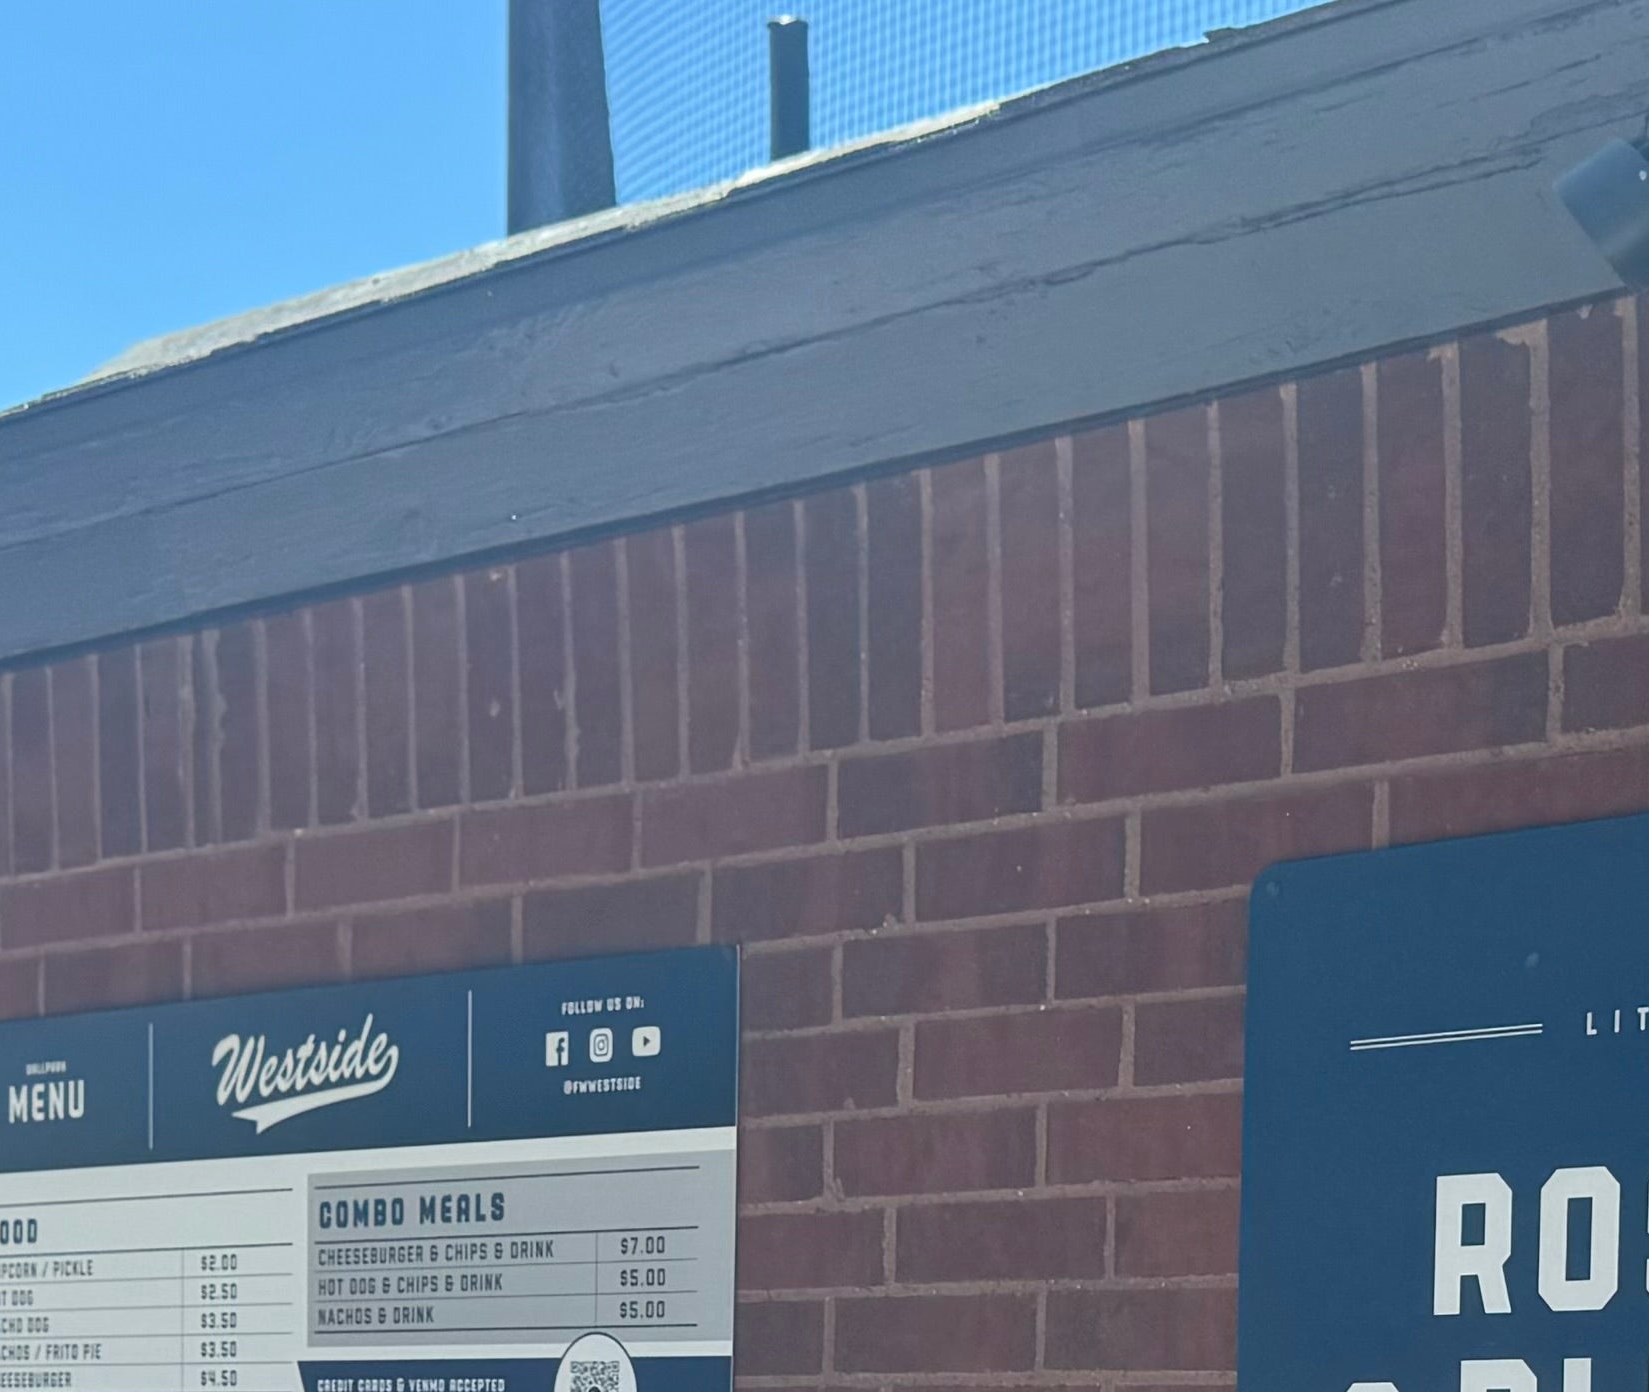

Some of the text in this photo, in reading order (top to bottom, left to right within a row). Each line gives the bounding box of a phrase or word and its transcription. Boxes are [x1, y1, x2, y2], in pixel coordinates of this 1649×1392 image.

[560, 999, 604, 1016] FOLLOW
[606, 996, 622, 1012] US
[211, 1012, 400, 1135] Westside
[8, 1078, 86, 1125] MENU
[318, 1191, 506, 1230] COMBO MEALS
[317, 1235, 666, 1266] CHEESEBURGER & CHIPS & DRINK $7.00
[52, 1258, 94, 1278] PICKLE
[200, 1253, 238, 1272] $2.00
[11, 1289, 34, 1307] DOG
[200, 1282, 238, 1301] $2.50
[317, 1267, 666, 1297] HOT DOG & CHIPS & DRINK $5.00
[27, 1316, 50, 1333] DOG
[200, 1311, 238, 1329] $3.50
[317, 1300, 666, 1326] NACHOS & DRINK $5.00
[45, 1343, 80, 1360] FRITO
[82, 1343, 102, 1360] PIE
[200, 1340, 238, 1359] $3.50
[200, 1369, 238, 1387] $4.50
[396, 1377, 405, 1392] &
